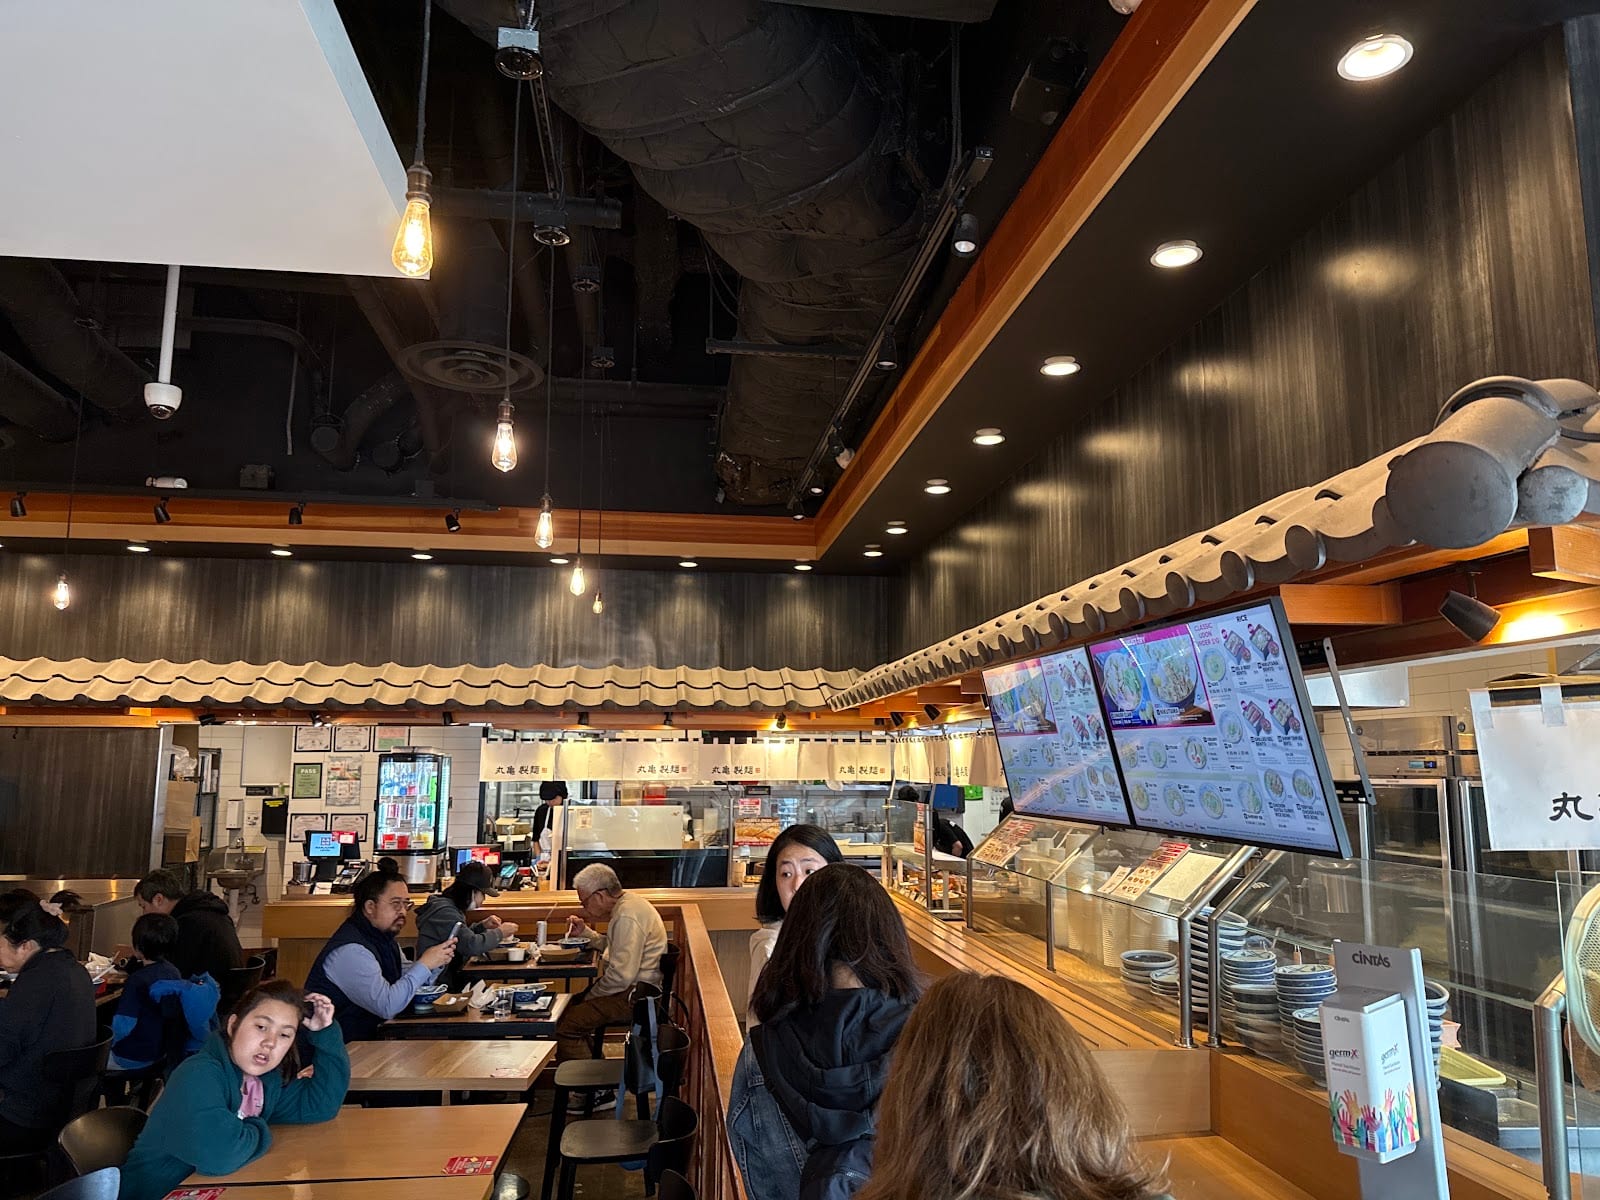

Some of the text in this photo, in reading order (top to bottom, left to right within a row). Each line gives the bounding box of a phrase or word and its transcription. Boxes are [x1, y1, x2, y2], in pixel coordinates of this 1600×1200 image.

[1236, 614, 1249, 622] RICE
[1549, 791, 1600, 821] 丸
[1352, 950, 1391, 968] CINTAS
